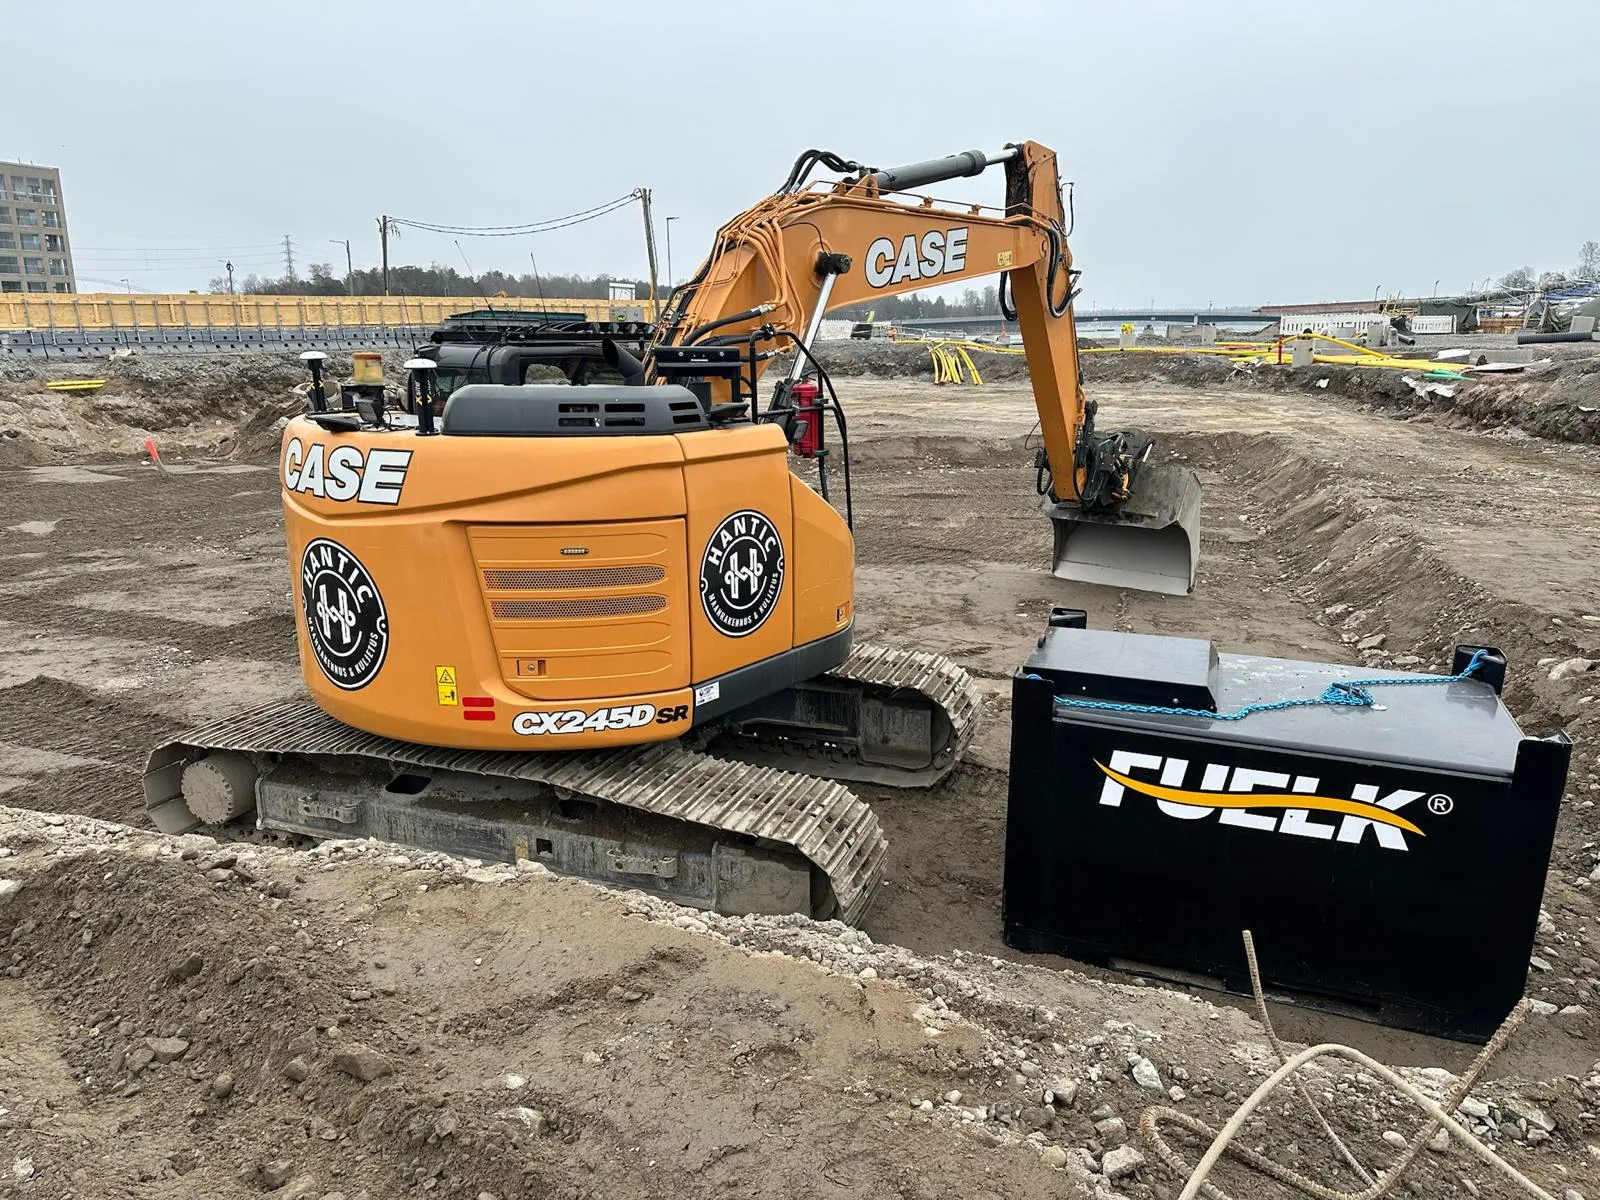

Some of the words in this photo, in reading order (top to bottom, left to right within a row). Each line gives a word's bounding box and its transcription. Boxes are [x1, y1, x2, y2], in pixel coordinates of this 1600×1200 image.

[865, 227, 969, 289] CASE
[284, 437, 414, 506] CASE
[707, 516, 777, 567] HANTIC
[303, 546, 374, 604] HANTIC
[758, 572, 779, 614] KULJETUS
[354, 632, 379, 674] KULJETUS
[512, 704, 657, 736] CX245D
[655, 704, 689, 725] SR
